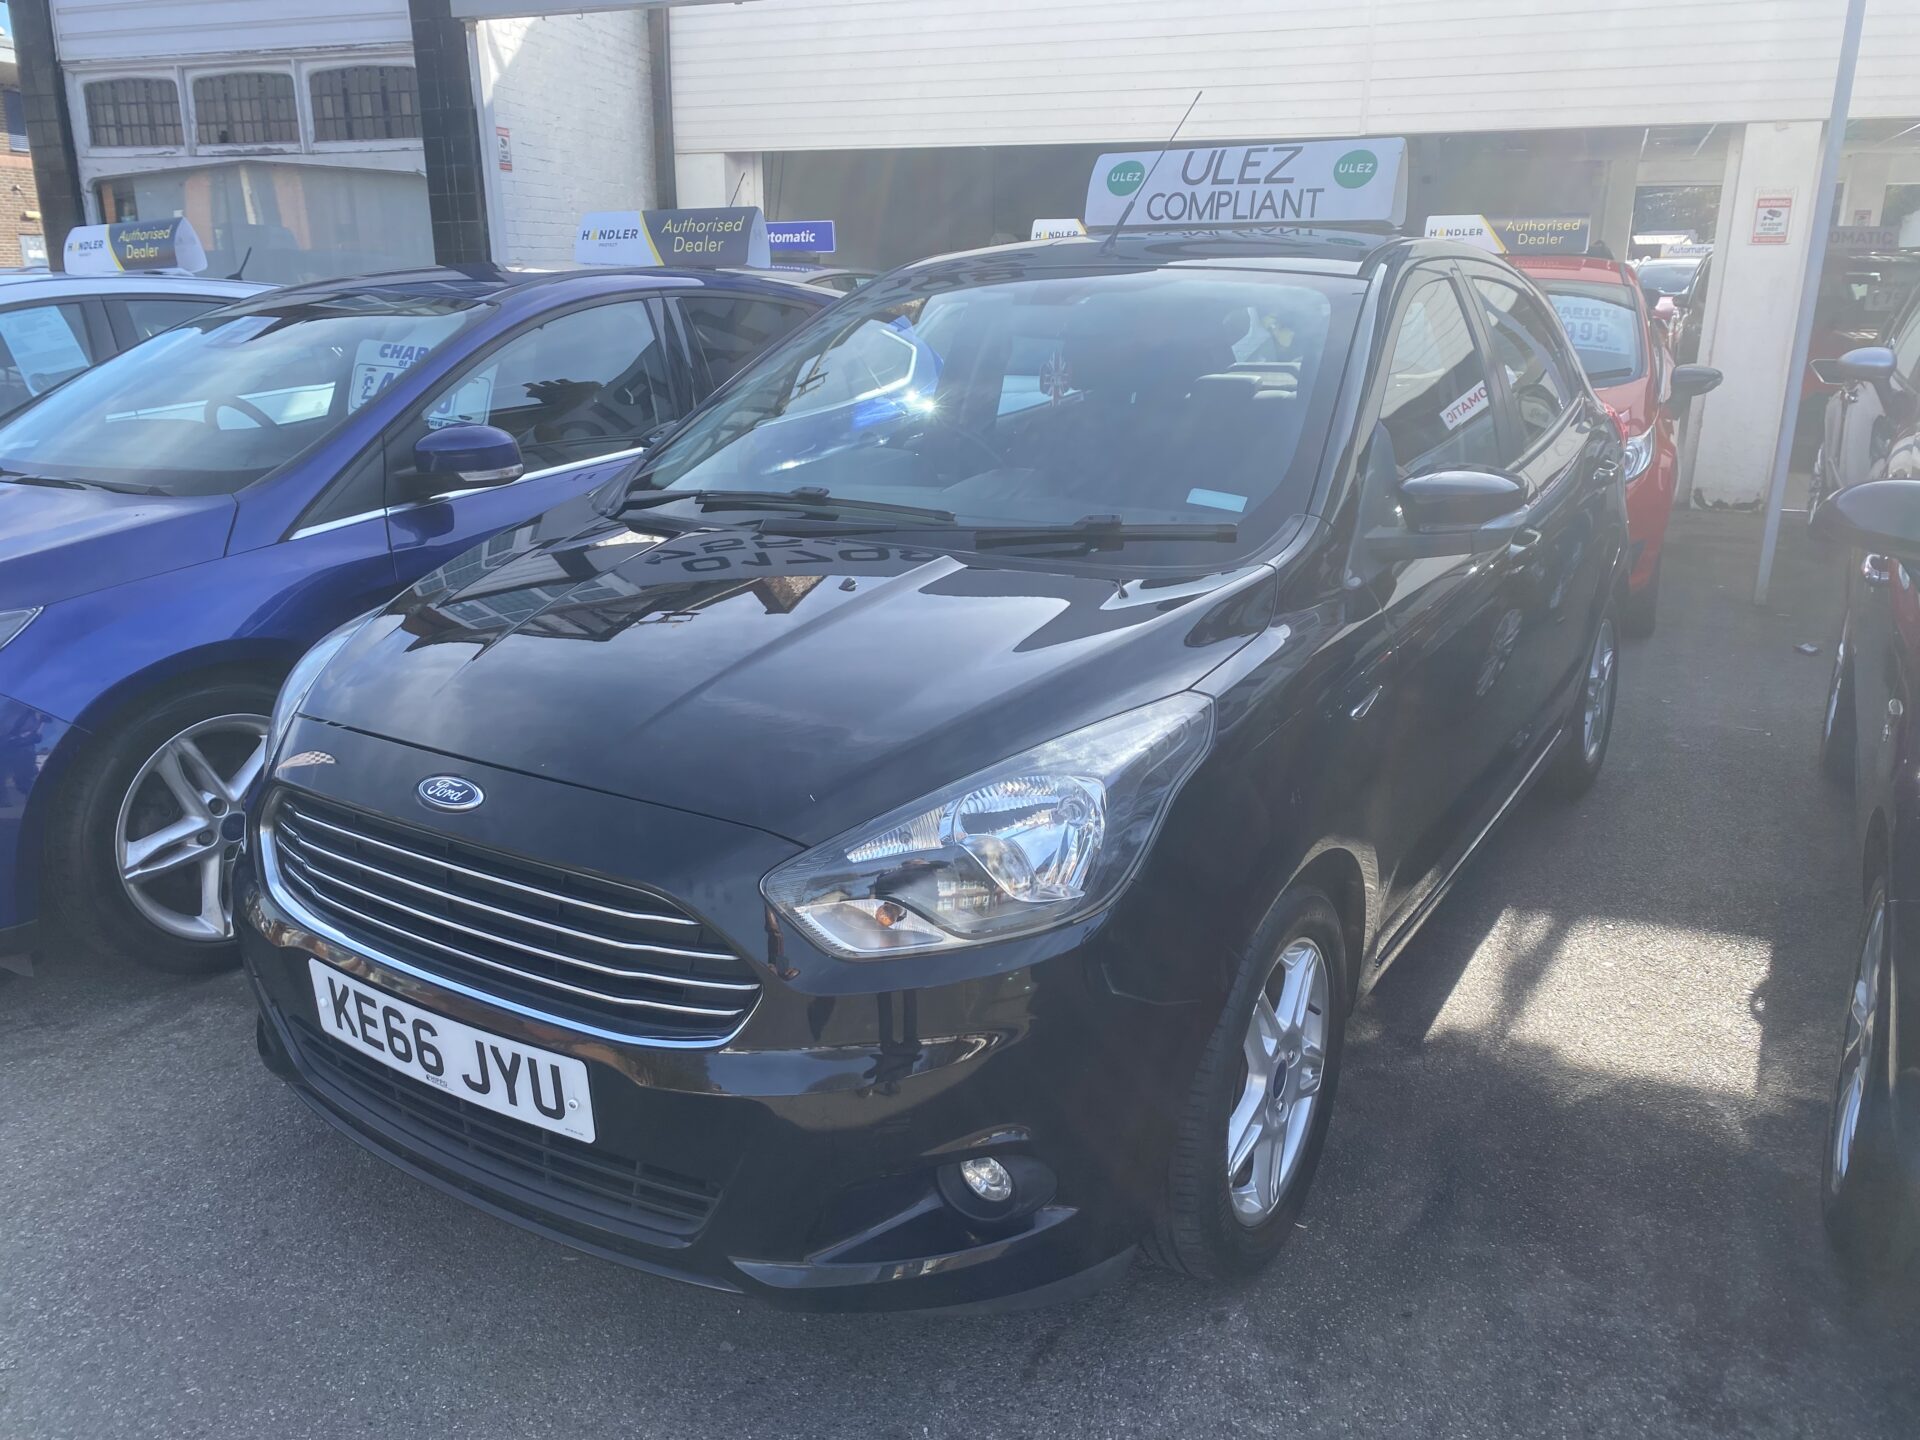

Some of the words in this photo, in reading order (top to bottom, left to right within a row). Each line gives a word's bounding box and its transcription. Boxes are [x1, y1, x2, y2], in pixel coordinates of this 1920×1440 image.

[1181, 146, 1304, 186] ULEZ
[1337, 161, 1373, 174] ULEZ
[1111, 170, 1141, 183] ULEZ
[1146, 188, 1325, 222] COMPLIANT
[118, 224, 173, 243] Authorised
[661, 216, 744, 234] Authorised
[1429, 228, 1484, 237] HANDLER
[1506, 219, 1582, 232] Authorised
[582, 228, 639, 241] HANDLER
[768, 230, 816, 243] tomatic
[1517, 233, 1565, 246] Dealer
[126, 242, 160, 259] Dealer
[673, 235, 725, 253] Dealer
[379, 343, 430, 360] CHAR
[427, 779, 469, 802] Ford
[327, 976, 444, 1077] KE66
[462, 1040, 566, 1120] JYU
